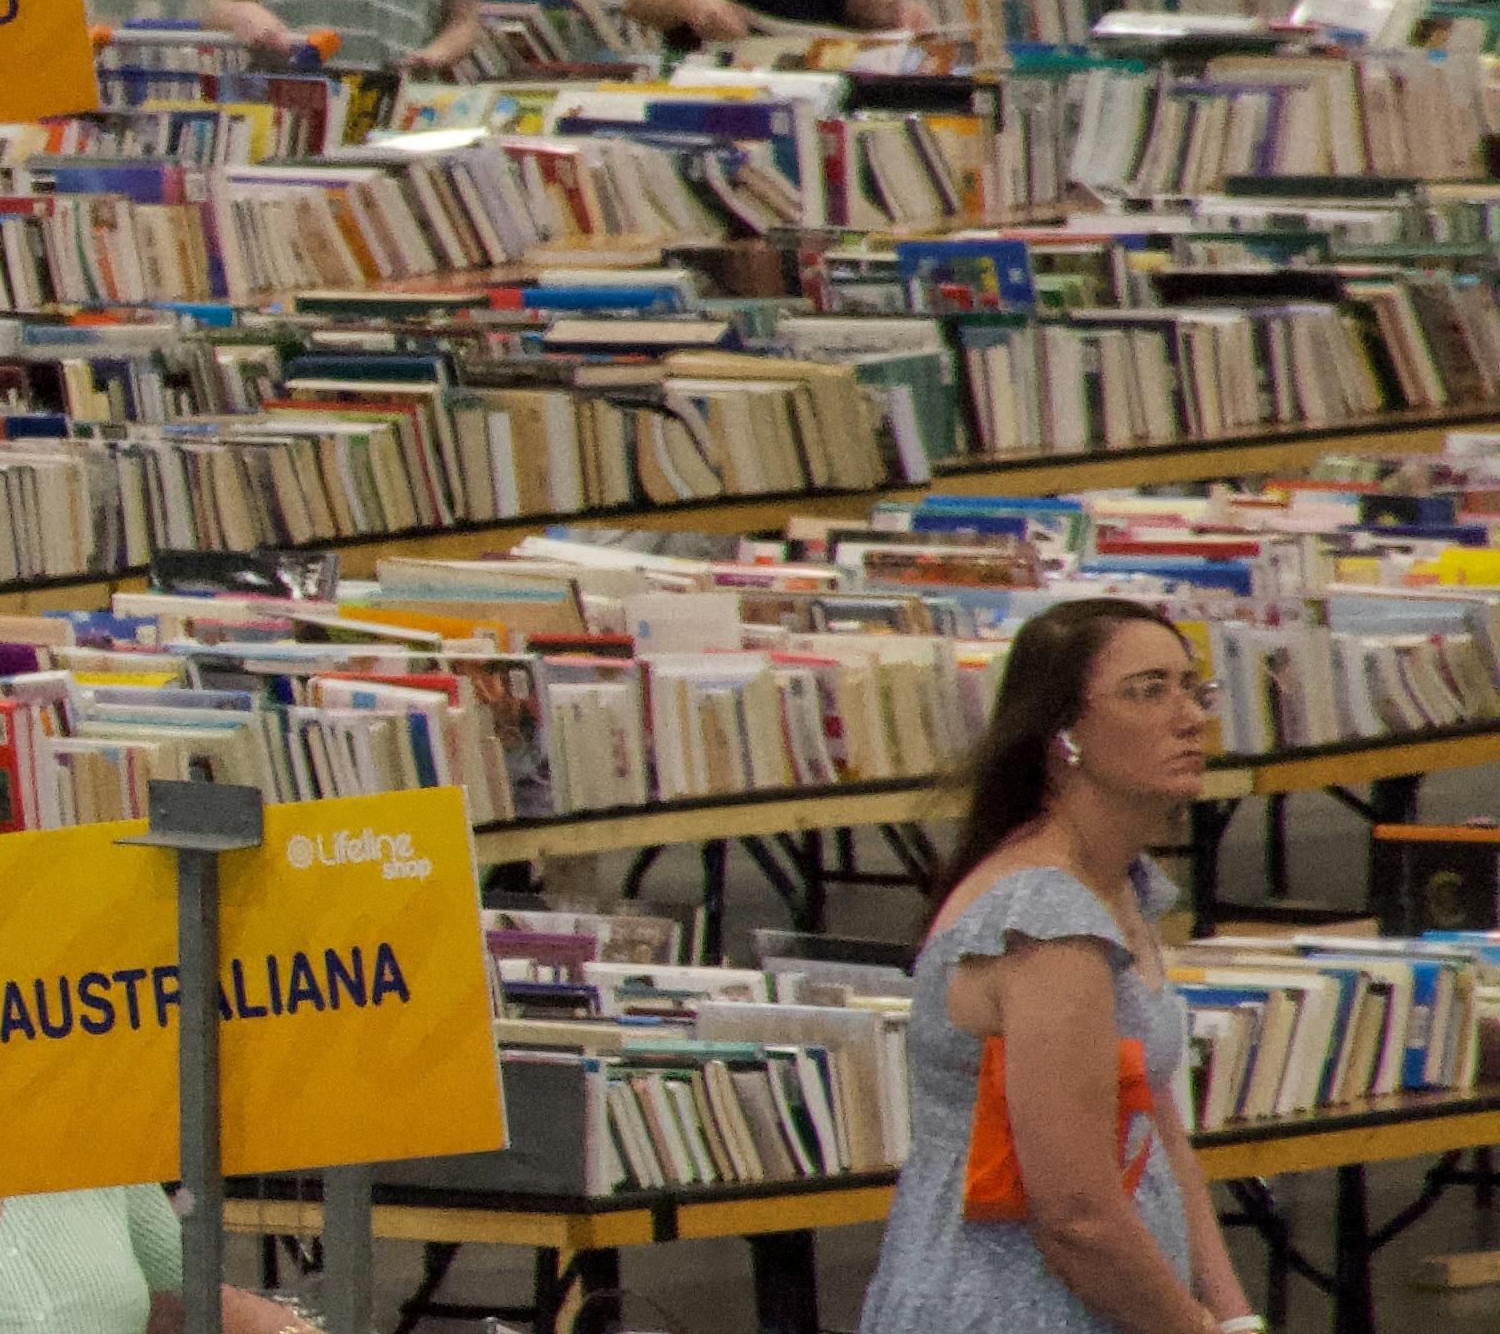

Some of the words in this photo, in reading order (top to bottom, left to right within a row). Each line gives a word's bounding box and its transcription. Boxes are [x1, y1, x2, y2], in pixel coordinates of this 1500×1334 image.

[316, 827, 415, 867] Lifeline
[381, 855, 434, 881] shop
[0, 941, 411, 1044] AUSTRLIANA
